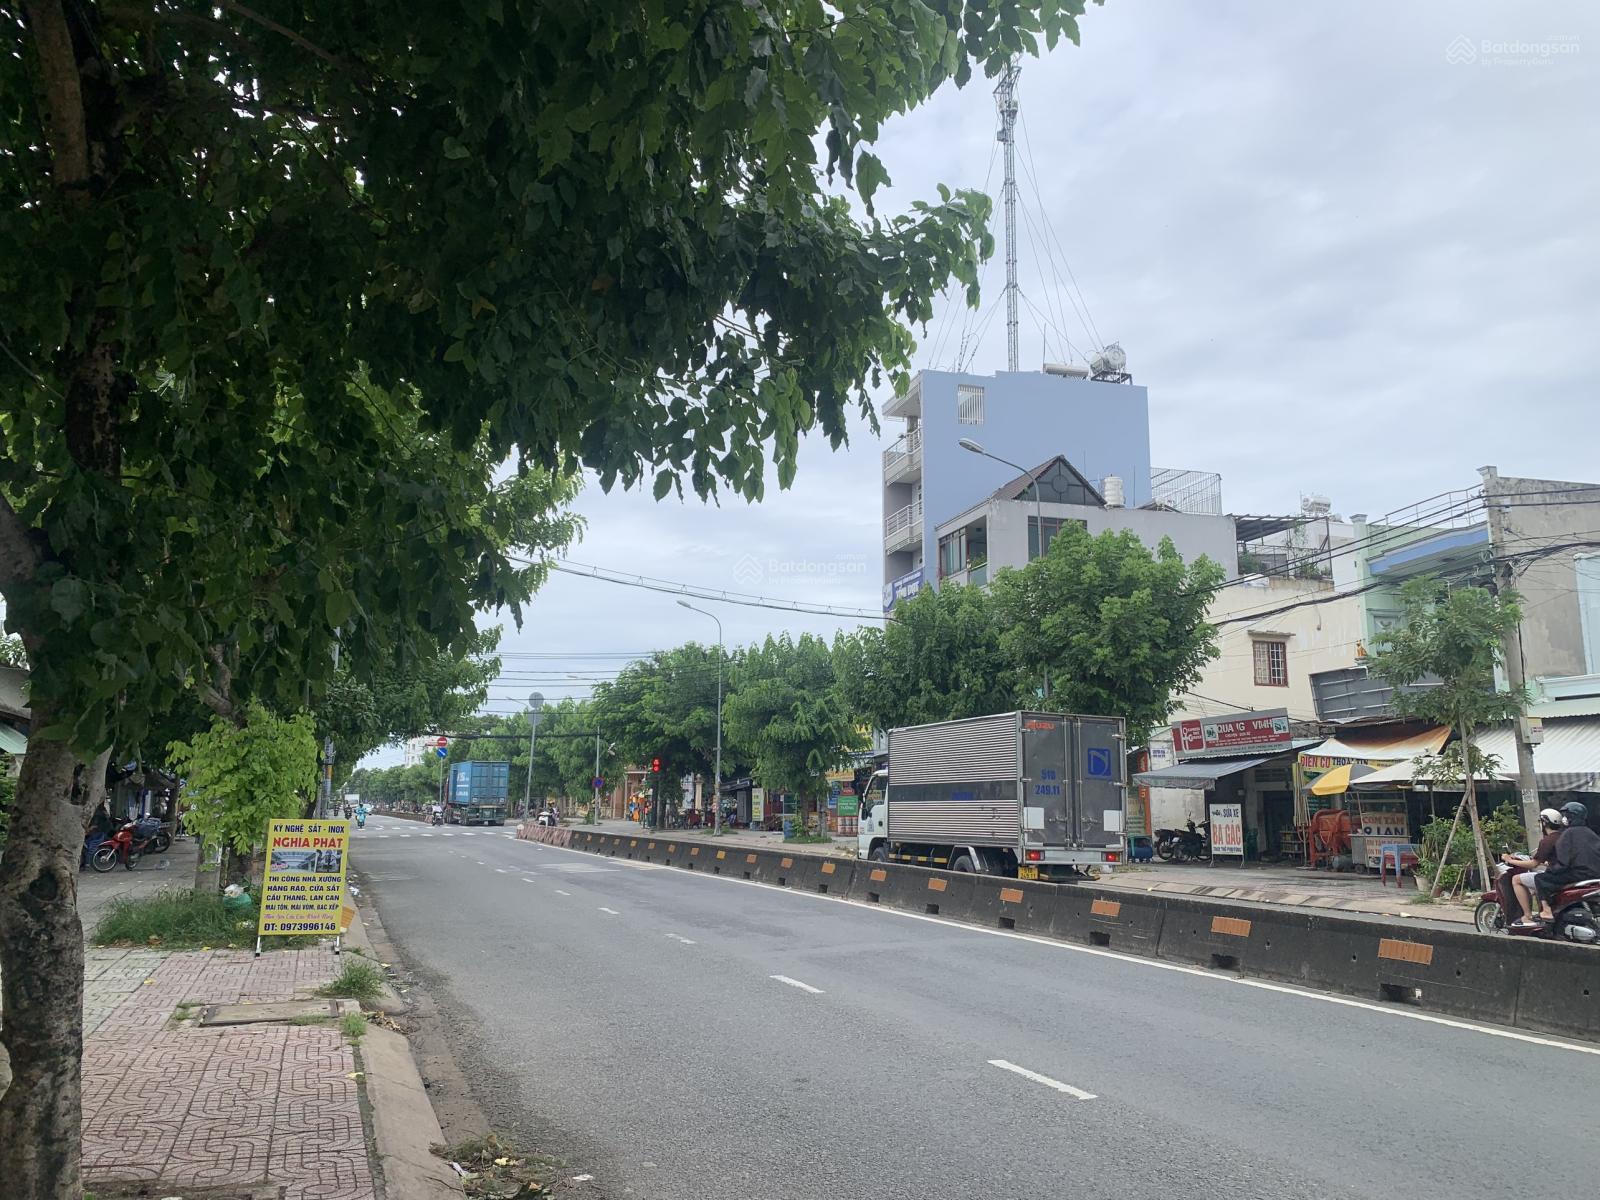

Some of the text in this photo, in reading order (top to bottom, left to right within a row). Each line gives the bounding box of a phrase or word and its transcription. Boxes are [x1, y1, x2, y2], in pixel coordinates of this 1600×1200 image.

[1034, 784, 1060, 795] 249.11
[1212, 823, 1223, 845] BA
[264, 922, 336, 931] ĐT: 0973996146
